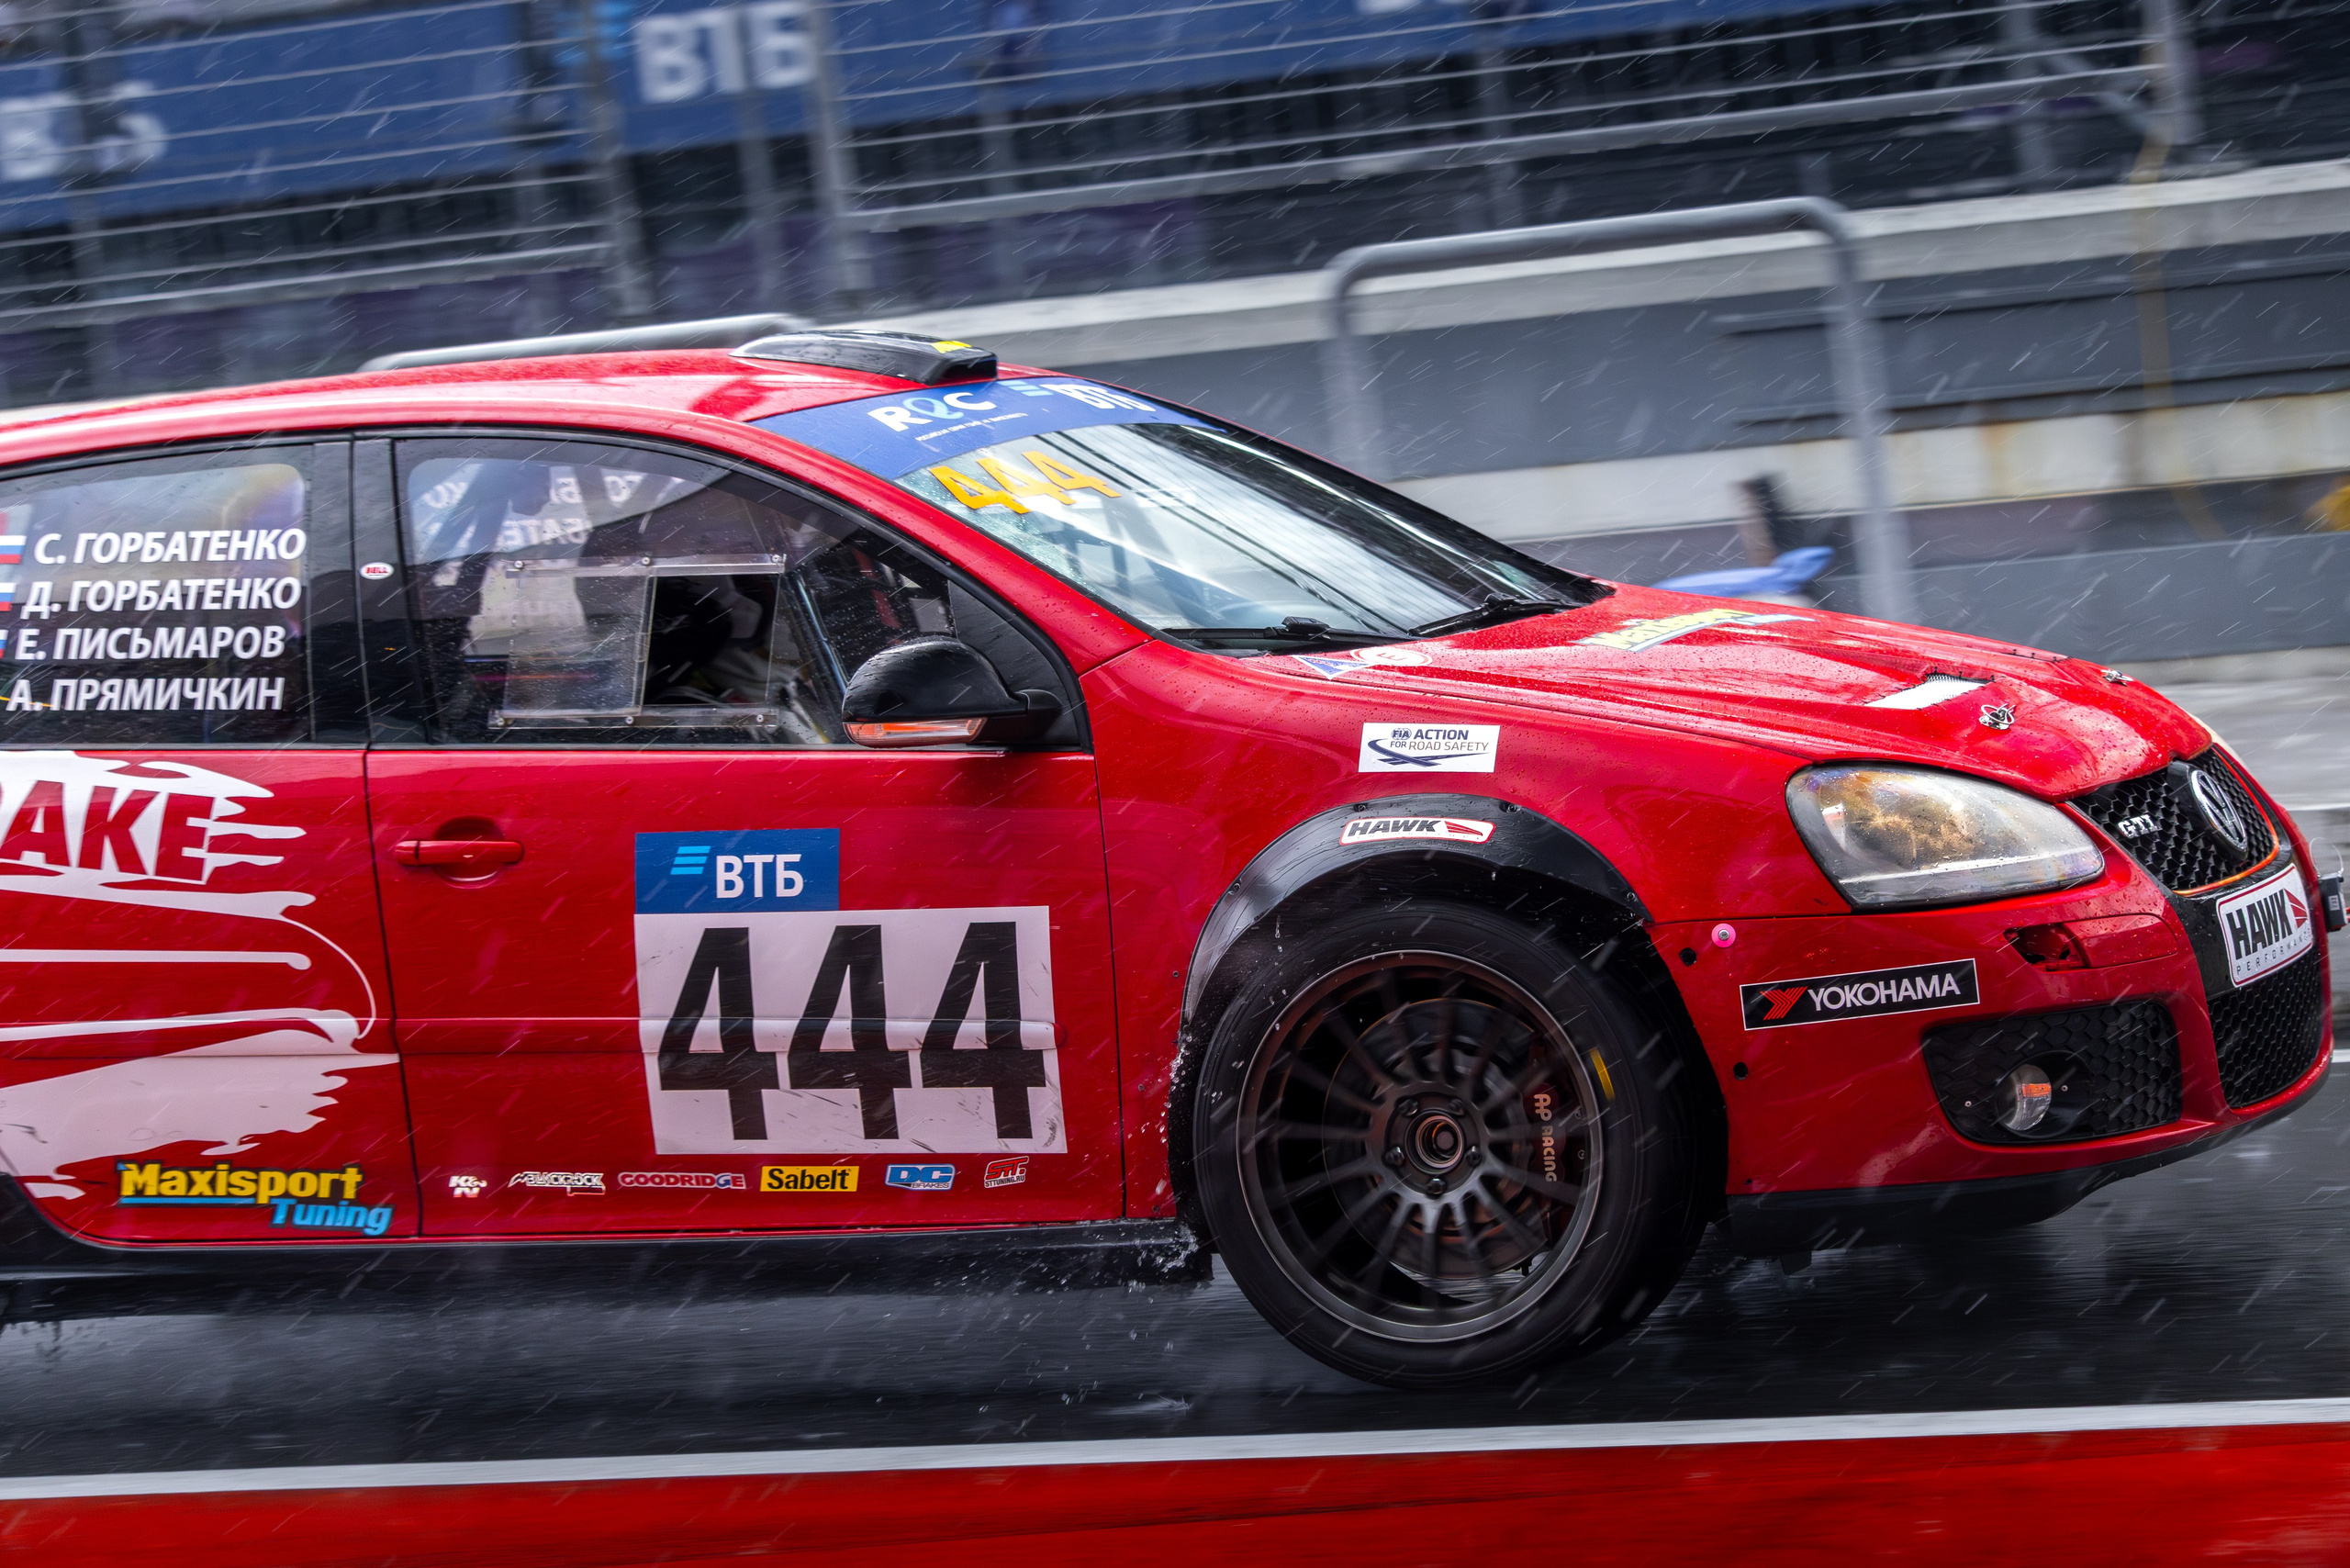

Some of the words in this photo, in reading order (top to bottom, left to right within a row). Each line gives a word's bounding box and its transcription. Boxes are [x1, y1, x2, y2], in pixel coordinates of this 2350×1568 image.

[929, 450, 1123, 515] 444
[34, 533, 66, 565] С.
[73, 529, 307, 565] ГОРБАТЕНКО
[20, 581, 62, 620] Д.
[68, 577, 302, 611] ГОРБАТЕНКО
[15, 628, 47, 661] Е.
[52, 625, 286, 661] ПИСЬМАРОВ
[6, 678, 43, 711] А.
[50, 678, 285, 711] ПРЯМИЧКИН
[1392, 728, 1412, 740] FIA
[1414, 729, 1469, 741] ACTION
[1408, 741, 1441, 751] ROAD
[1444, 742, 1490, 752] SAFETY
[0, 779, 216, 882] AKE
[1348, 820, 1442, 837] HAWK
[2118, 813, 2163, 839] GTI
[715, 854, 805, 899] ВТБ
[2225, 888, 2293, 961] HAWK
[2236, 925, 2312, 975] PERFOR
[1807, 973, 1961, 1012] YOKOHAMA
[657, 921, 1047, 1141] 444
[1533, 1093, 1552, 1122] AP
[1542, 1126, 1558, 1182] RACING
[120, 1163, 363, 1204] Maxisport
[619, 1172, 745, 1189] GOODRIDGE
[767, 1168, 850, 1191] Sabelt
[888, 1166, 954, 1183] DC
[984, 1176, 1025, 1188] STTUNING.RU
[270, 1197, 393, 1236] Tuning
